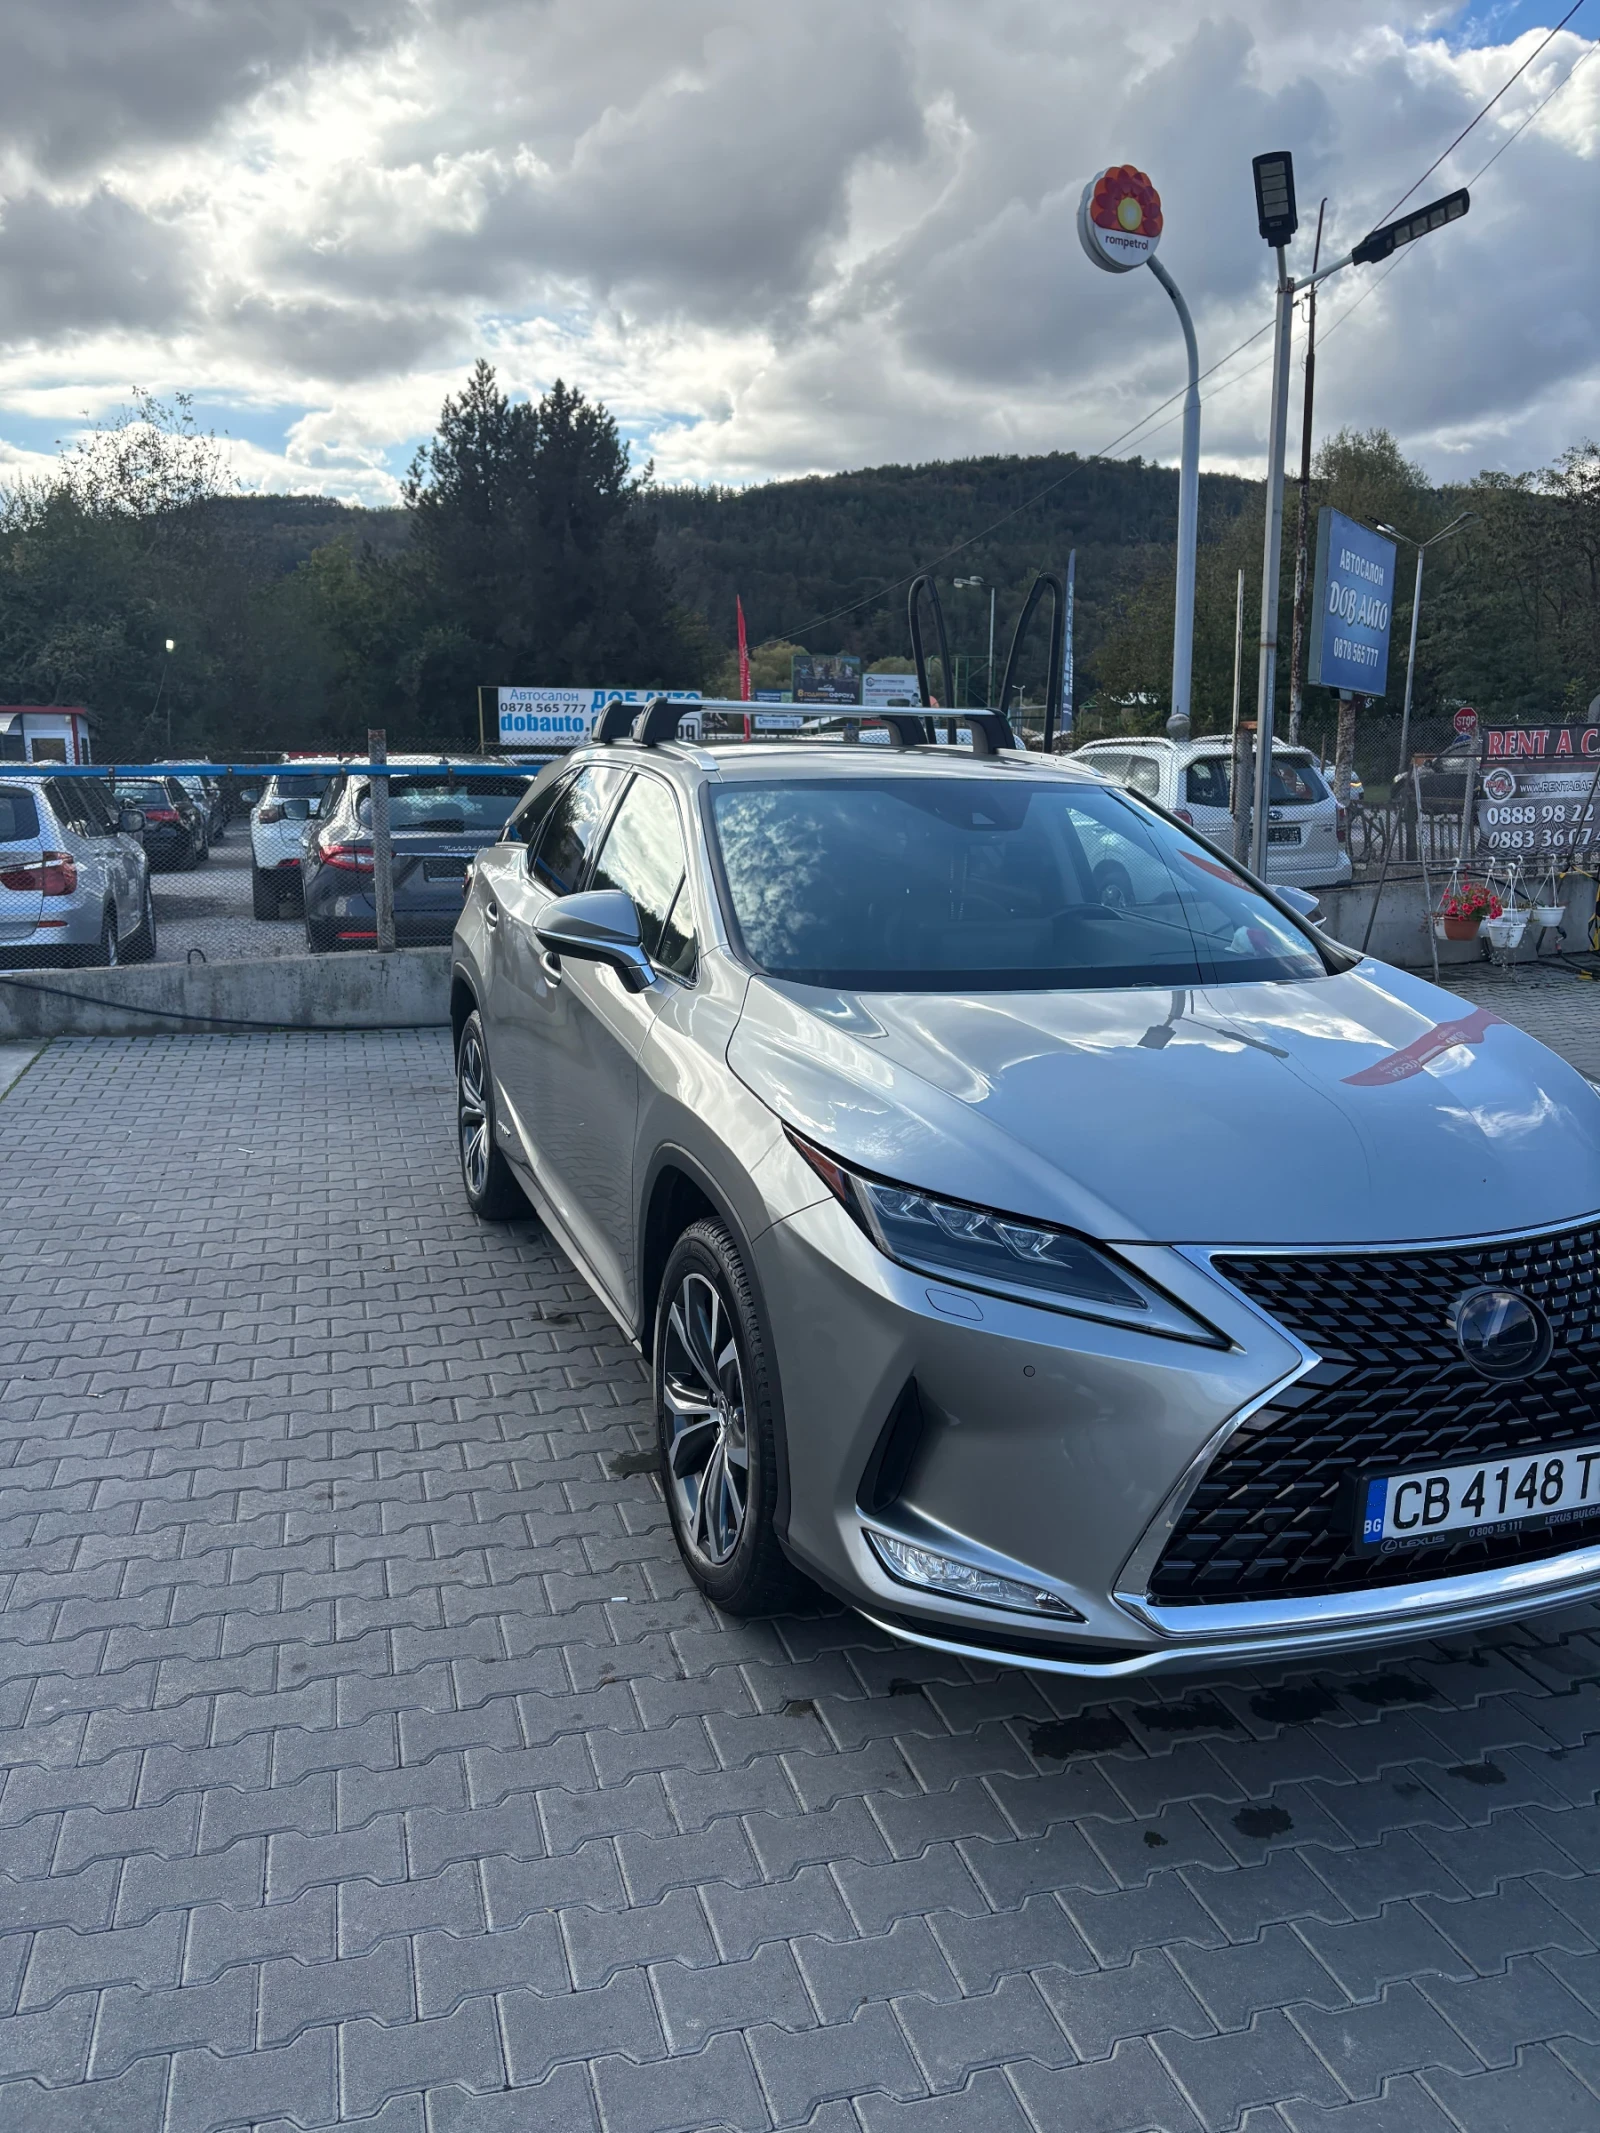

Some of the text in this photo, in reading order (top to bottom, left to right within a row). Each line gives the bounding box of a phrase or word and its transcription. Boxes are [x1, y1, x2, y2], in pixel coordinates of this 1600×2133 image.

[1105, 235, 1149, 250] rompetrol
[1340, 548, 1384, 586] АВТОСАЛОН
[1333, 637, 1379, 668] 0878 565 777
[510, 688, 579, 702] Автосалон
[500, 703, 586, 713] 0878 565 777
[1456, 716, 1476, 726] STOP
[1487, 730, 1550, 760] RENT
[1554, 729, 1574, 758] A
[1486, 804, 1594, 825] 0888 98 22
[1488, 831, 1535, 849] 0883
[1541, 829, 1565, 847] 36
[1393, 1476, 1450, 1530] CB
[1461, 1458, 1564, 1518] 4148
[1364, 1518, 1381, 1534] BG
[1399, 1534, 1445, 1548] LEXUS
[1469, 1528, 1475, 1538] 0
[1476, 1526, 1494, 1537] 800
[1496, 1524, 1507, 1534] 15
[1508, 1521, 1523, 1532] 111
[1545, 1512, 1571, 1525] LEXUS
